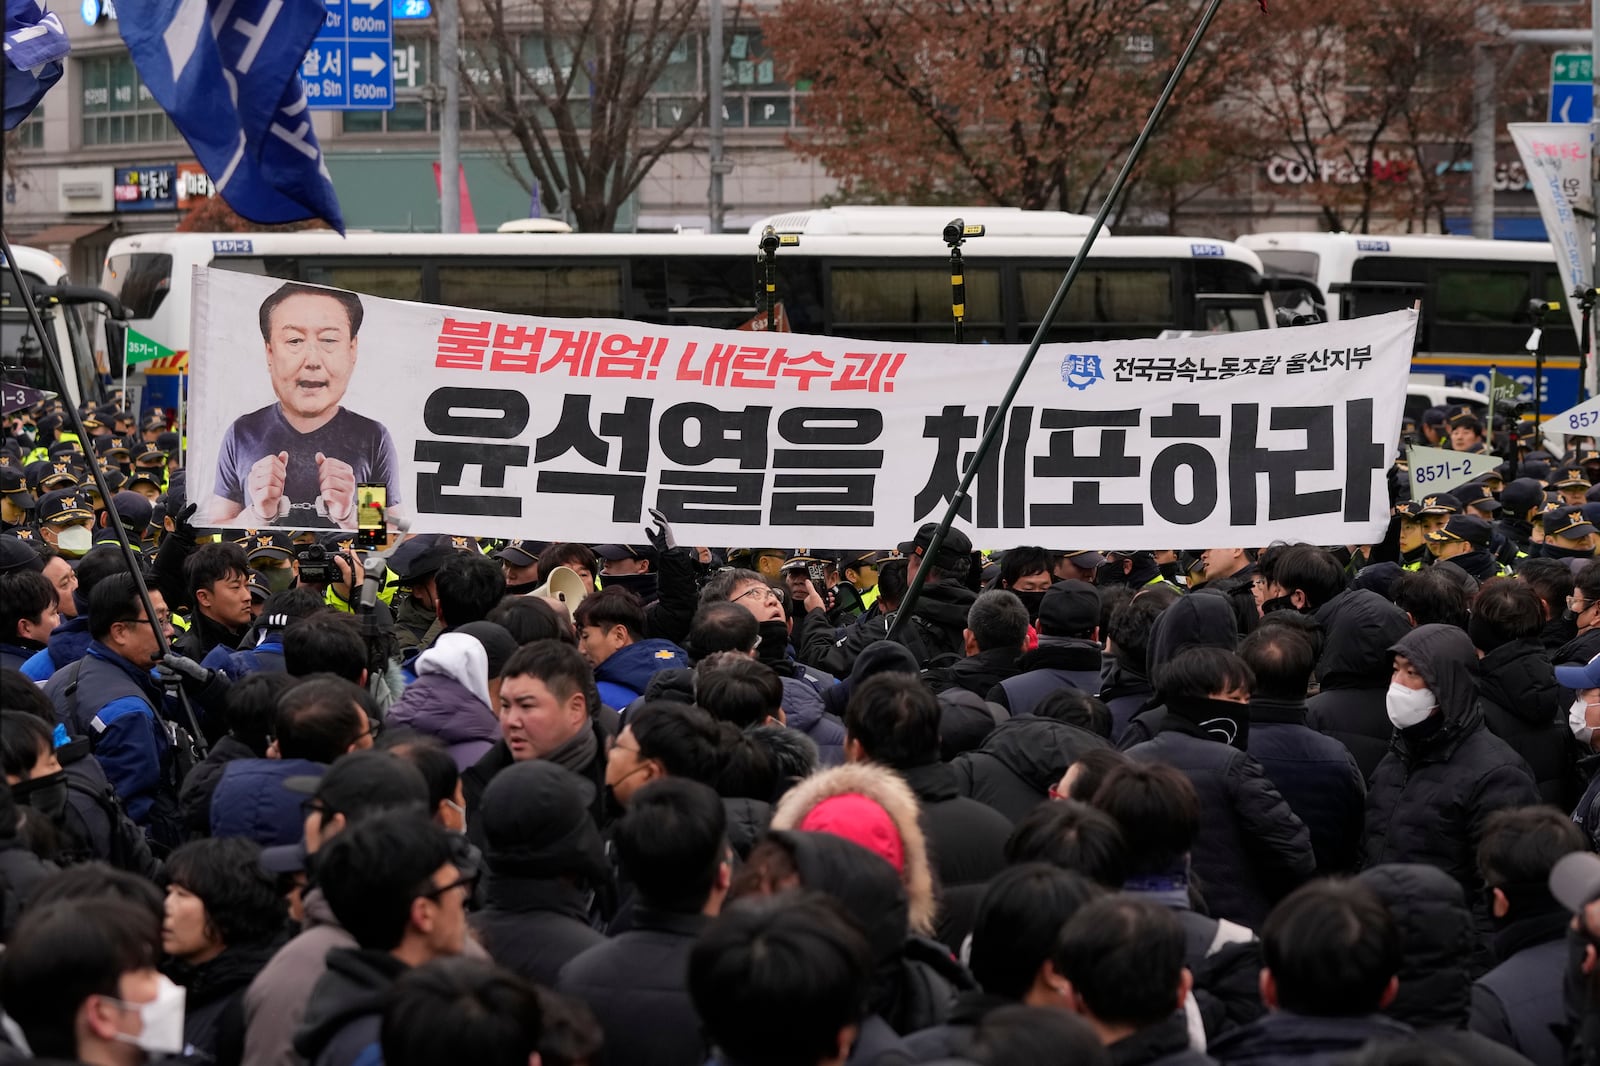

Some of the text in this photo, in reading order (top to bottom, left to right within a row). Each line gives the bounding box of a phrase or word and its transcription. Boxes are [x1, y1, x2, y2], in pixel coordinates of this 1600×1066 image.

[406, 0, 425, 15] 2F
[326, 11, 341, 27] Ctr
[352, 17, 386, 32] 800m
[302, 48, 341, 77] 찰서
[323, 79, 342, 98] Stn
[353, 84, 387, 99] 500m
[215, 240, 249, 252] 54기-2
[128, 342, 158, 356] 35기-1
[435, 318, 908, 393] 불법계엄! 내란수괴!
[1075, 355, 1096, 377] 금속
[1113, 345, 1373, 383] 전국금속노동조합 울산지부
[413, 386, 1386, 529] 윤석열을 체포하라
[1416, 459, 1472, 483] 85기-2
